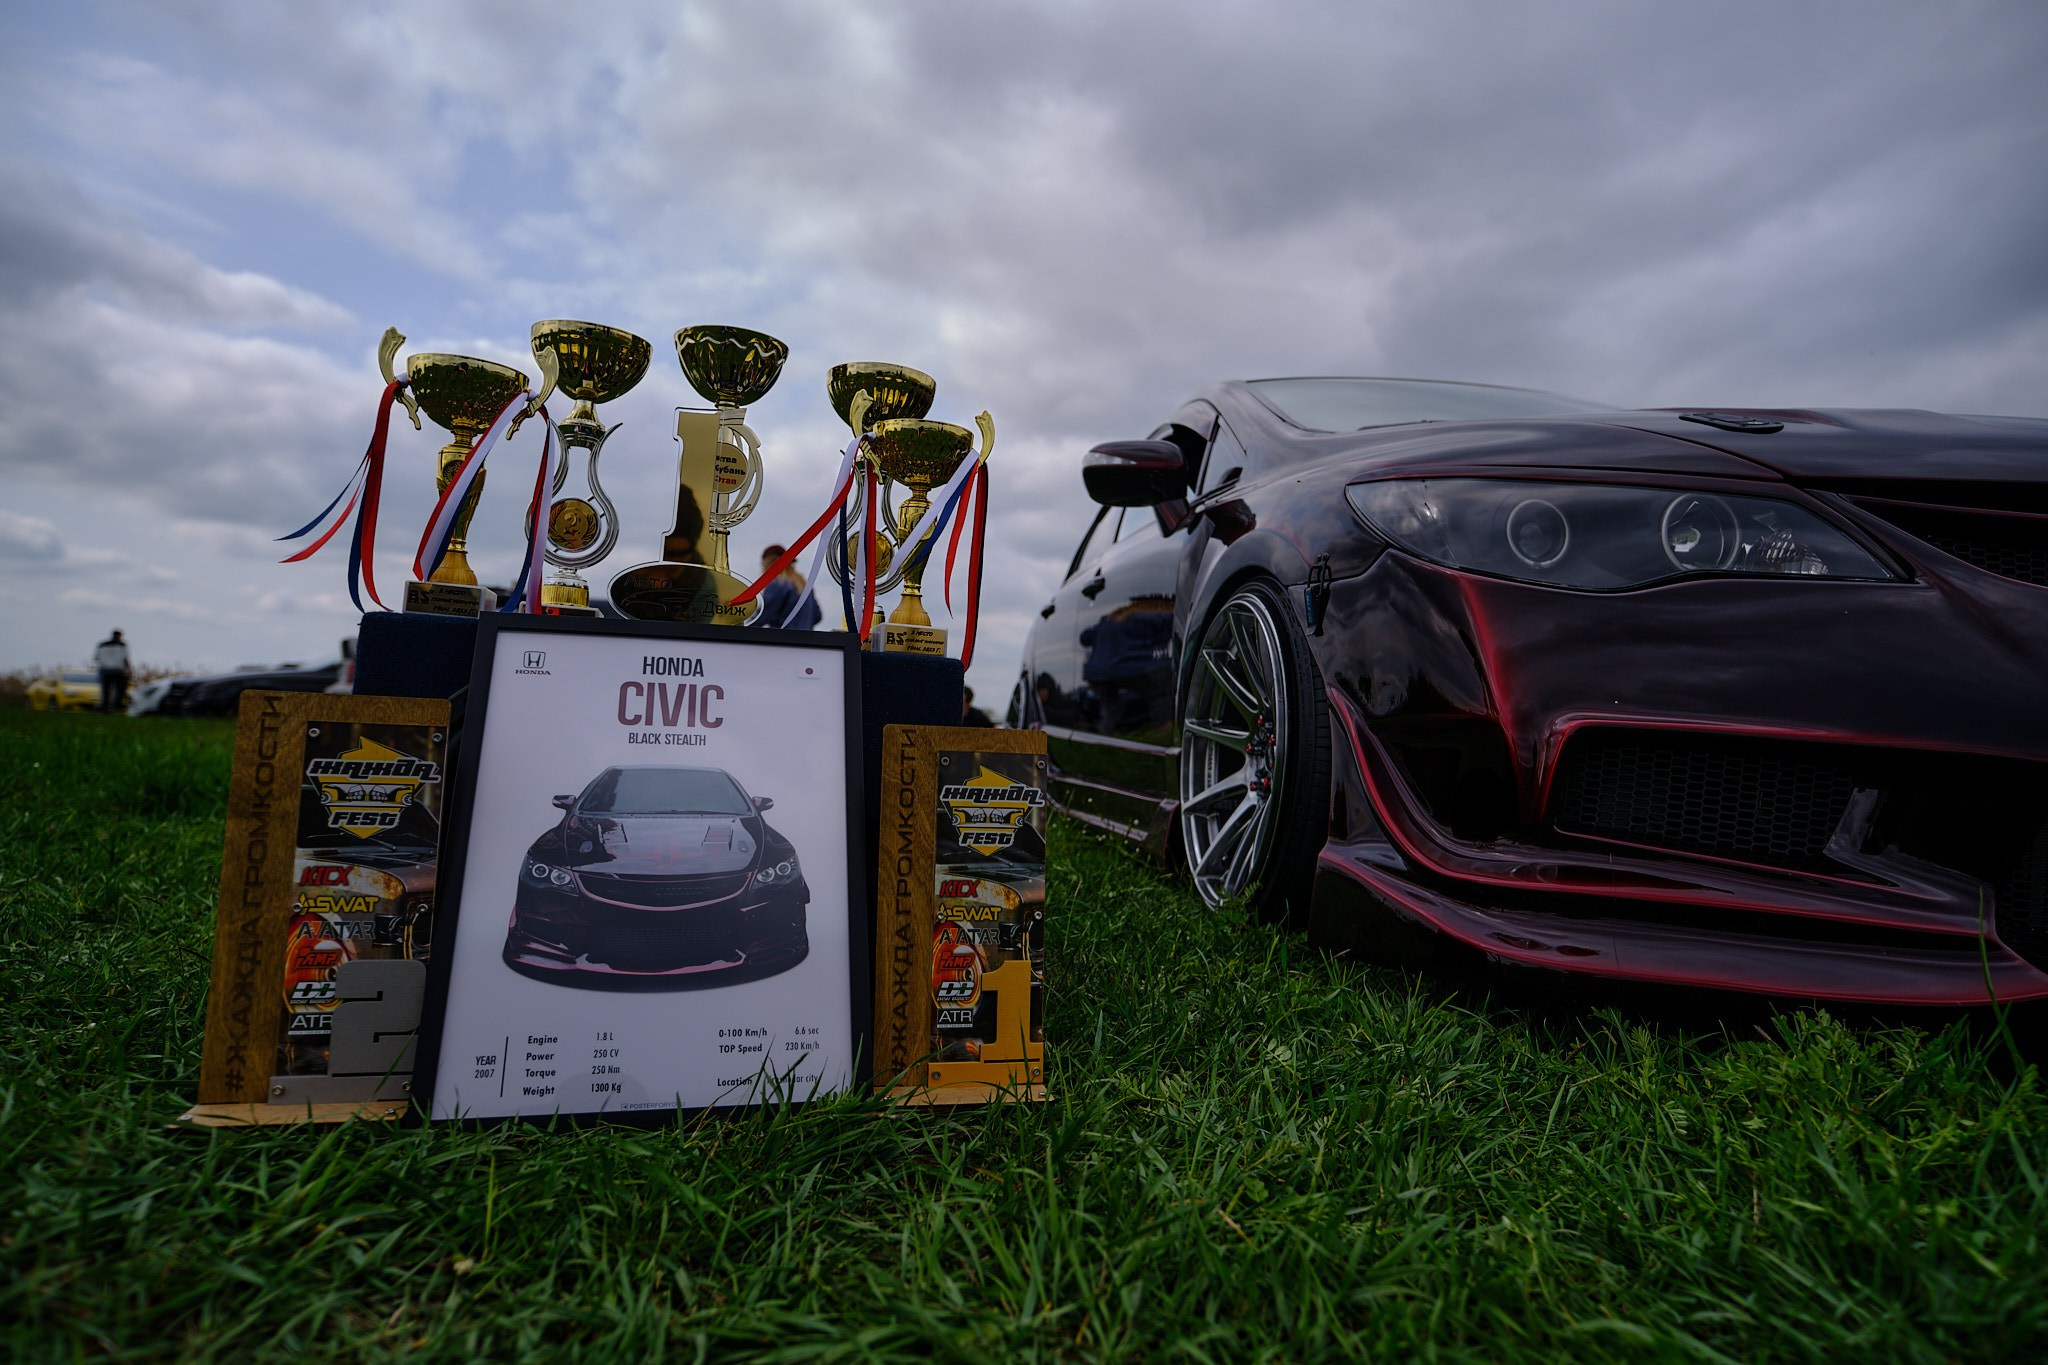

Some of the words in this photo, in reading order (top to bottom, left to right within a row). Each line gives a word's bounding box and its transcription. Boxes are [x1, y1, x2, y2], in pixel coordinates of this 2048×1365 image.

[642, 656, 705, 677] HONDA
[617, 681, 725, 729] CIVIC
[628, 732, 662, 745] BLACK
[664, 733, 707, 746] STEALTH
[301, 866, 352, 887] KICX
[939, 880, 980, 897] KICX
[314, 895, 380, 914] SWAT
[952, 906, 1002, 921] SWAT
[939, 1010, 972, 1023] ATR
[527, 1035, 558, 1046] Engine
[596, 1032, 607, 1041] 1.8
[609, 1032, 614, 1041] L
[718, 1029, 743, 1038] 0-100
[745, 1028, 768, 1038] Km/h
[795, 1026, 806, 1035] 6.6
[808, 1027, 819, 1035] sec
[525, 1052, 555, 1061] Power
[593, 1050, 608, 1059] 250
[610, 1049, 619, 1058] CV
[719, 1045, 736, 1053] TOP
[738, 1044, 763, 1055] Speed
[785, 1041, 799, 1051] 230
[800, 1041, 820, 1051] Km/h
[475, 1055, 497, 1066] YEAR
[474, 1068, 495, 1079] 2007
[525, 1068, 556, 1079] Torque
[591, 1065, 606, 1075] 250
[608, 1065, 620, 1074] Nm
[523, 1086, 555, 1097] Weight
[591, 1083, 610, 1093] 1300
[611, 1083, 622, 1093] Kg
